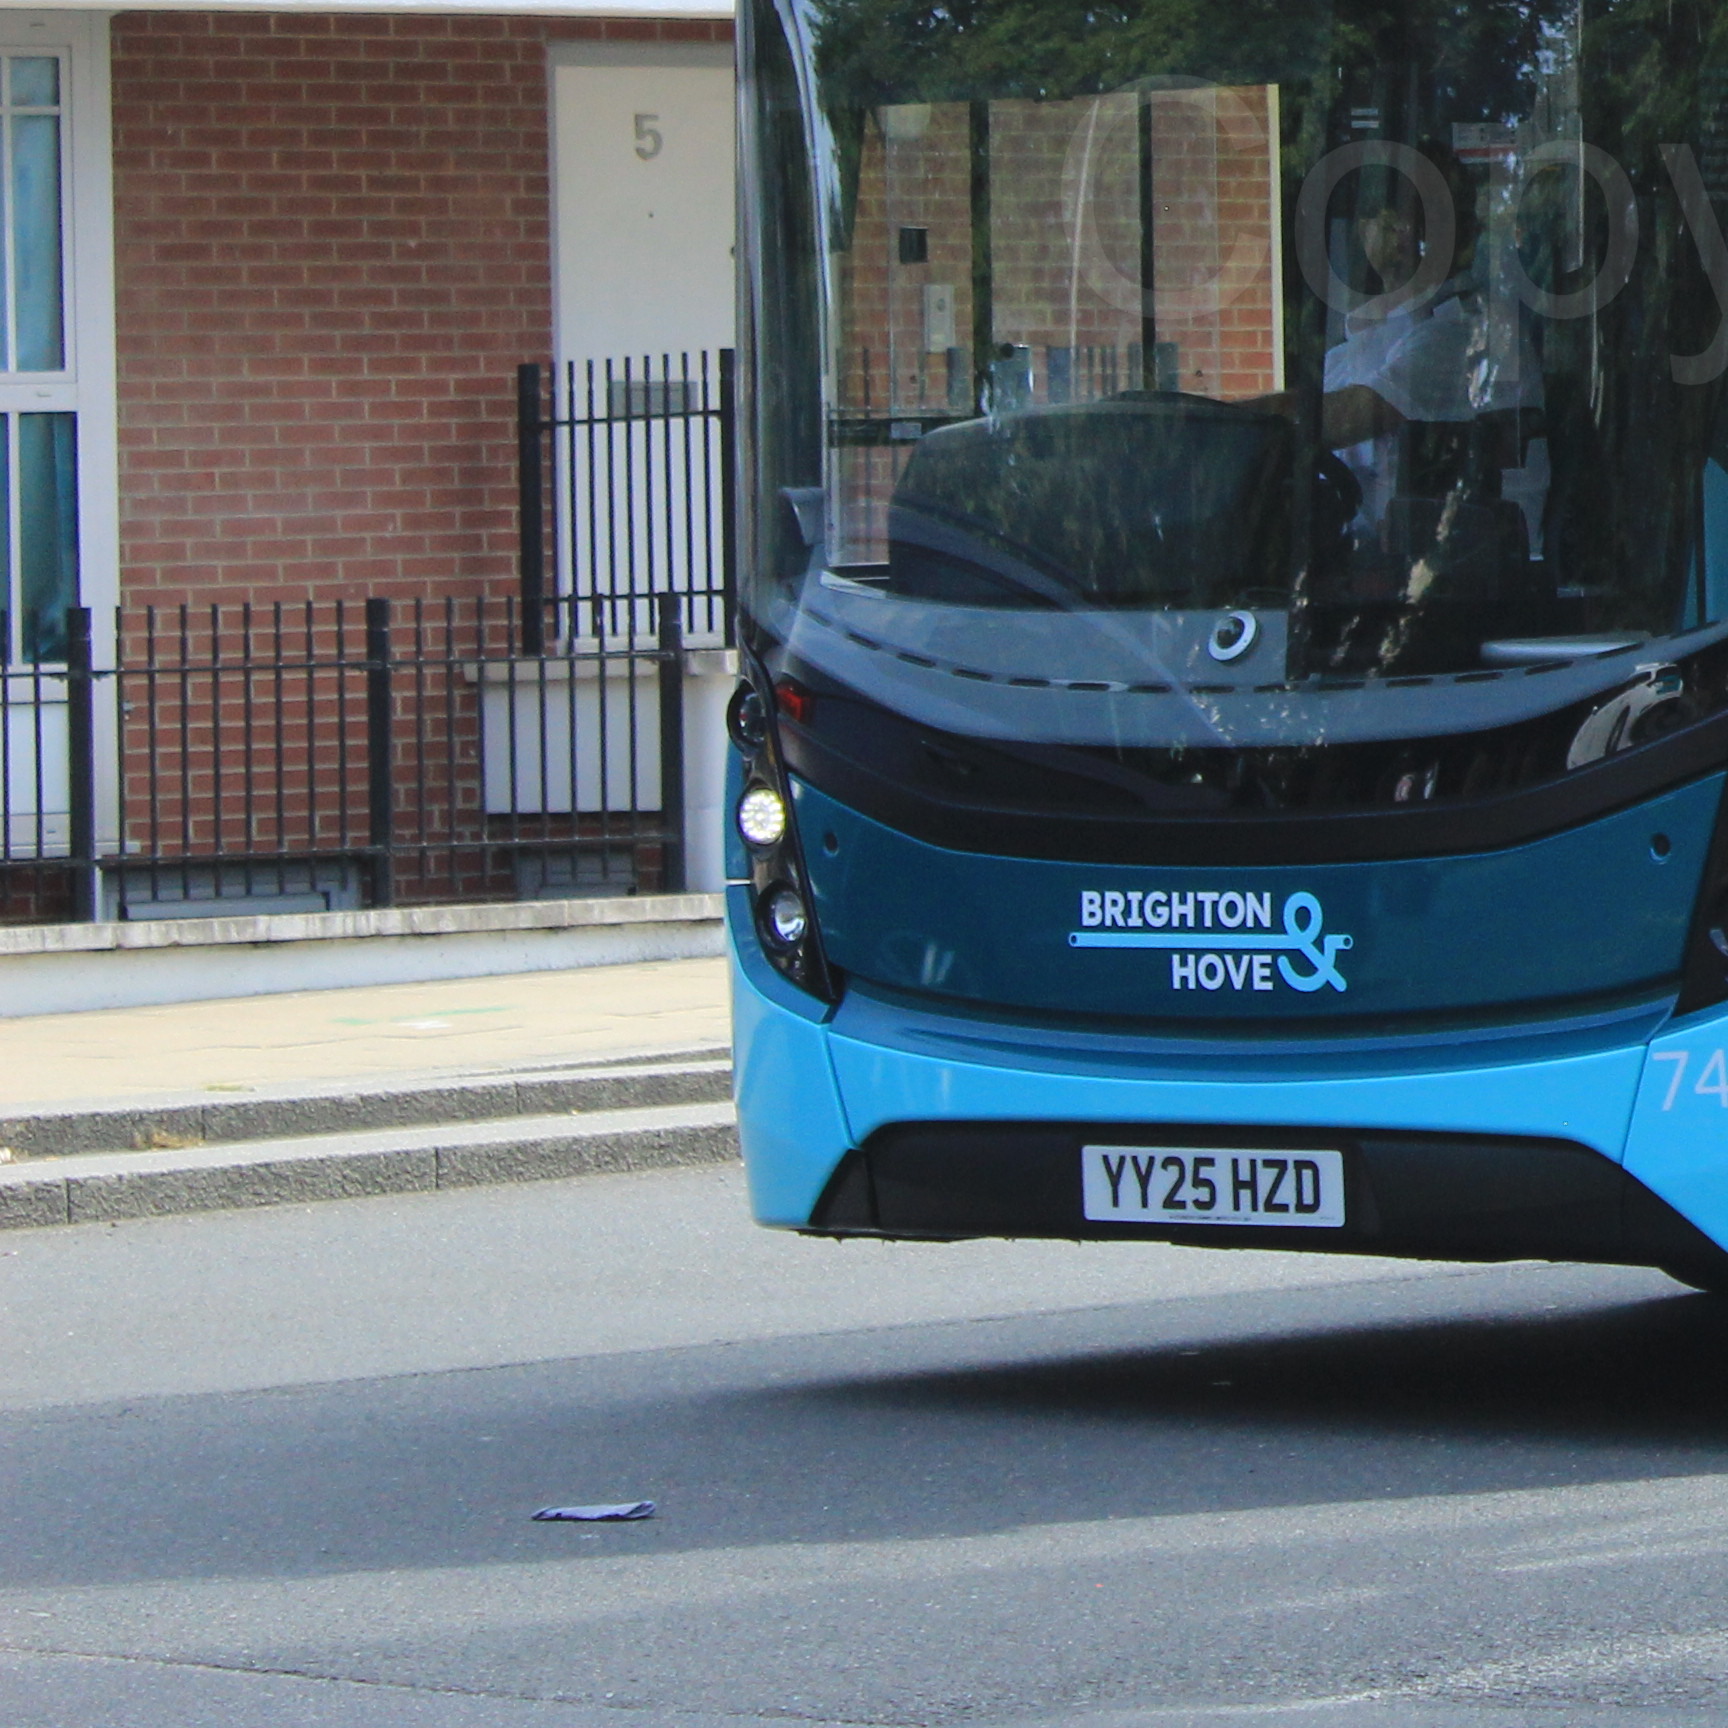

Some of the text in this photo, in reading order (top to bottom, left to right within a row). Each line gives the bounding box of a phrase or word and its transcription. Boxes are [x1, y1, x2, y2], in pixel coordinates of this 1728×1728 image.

[632, 113, 663, 161] 5
[1081, 891, 1271, 928] BRIGHTON
[1172, 953, 1273, 991] HOVE
[1102, 1154, 1321, 1214] YY25 HZD
